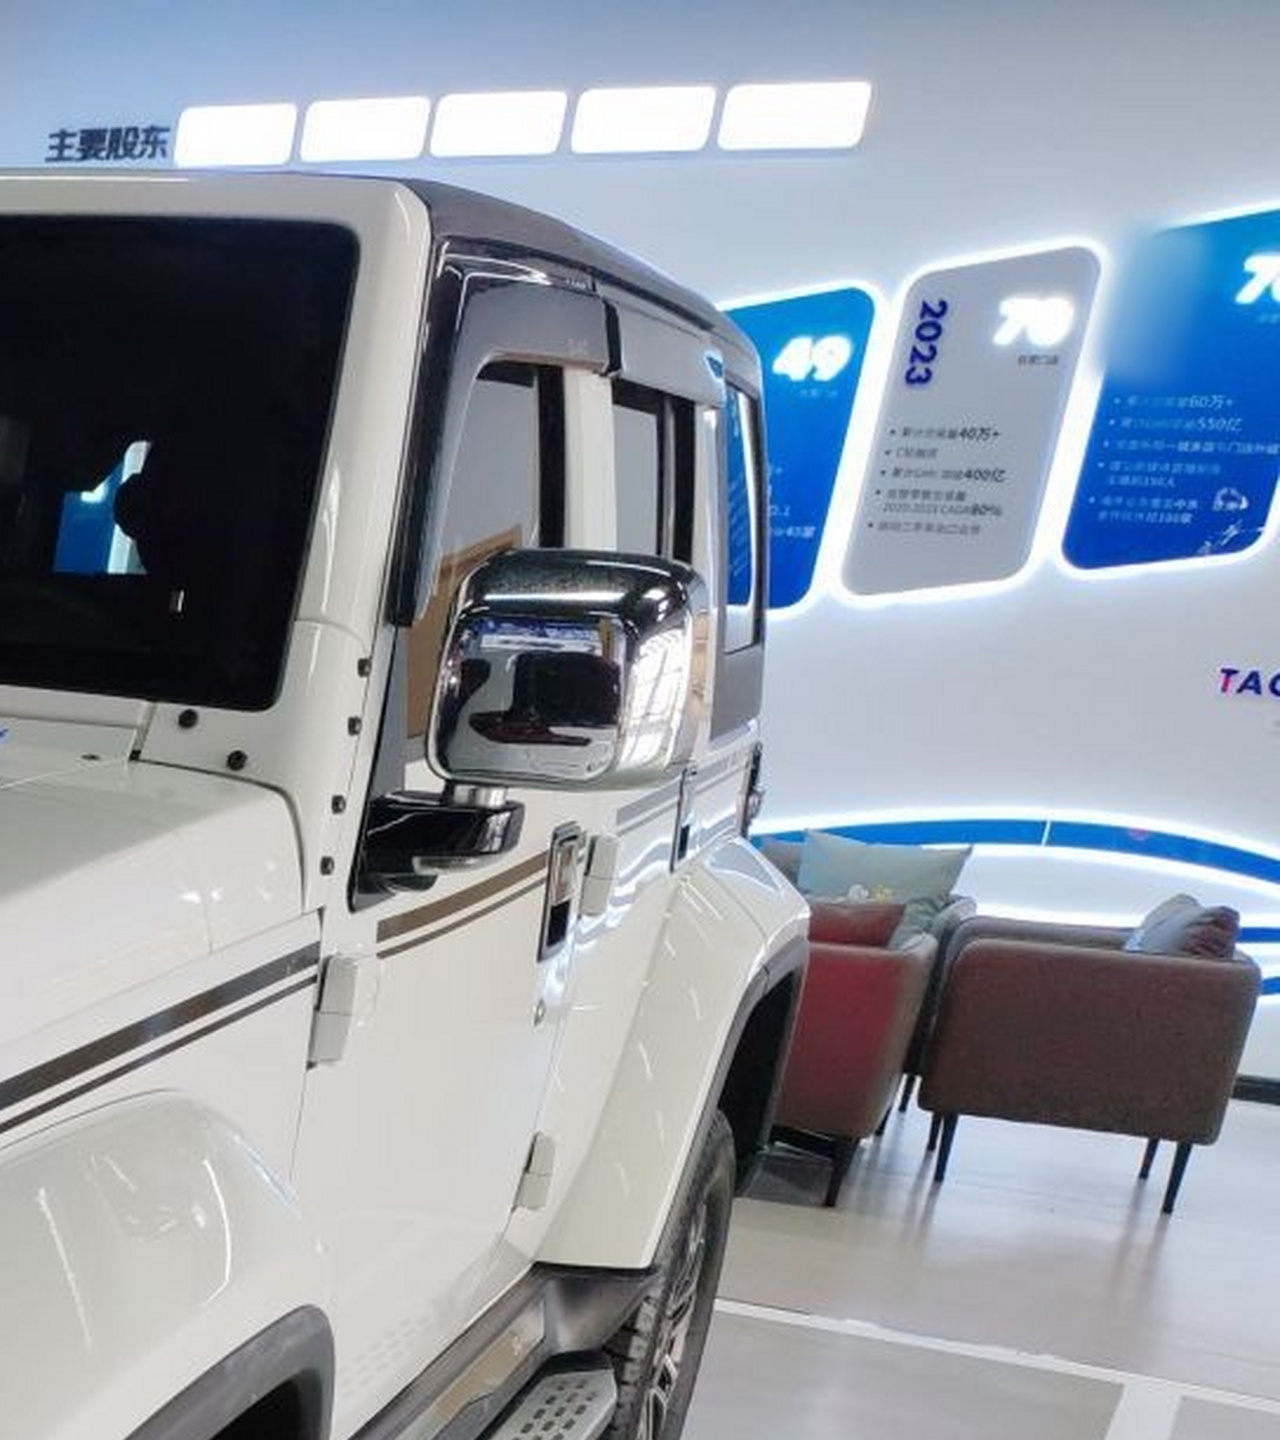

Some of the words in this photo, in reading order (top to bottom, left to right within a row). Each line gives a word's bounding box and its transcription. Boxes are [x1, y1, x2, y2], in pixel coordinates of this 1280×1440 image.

[44, 124, 171, 163] 主要股东
[904, 298, 949, 386] 2023
[993, 298, 1075, 347] 70
[771, 334, 853, 382] 49
